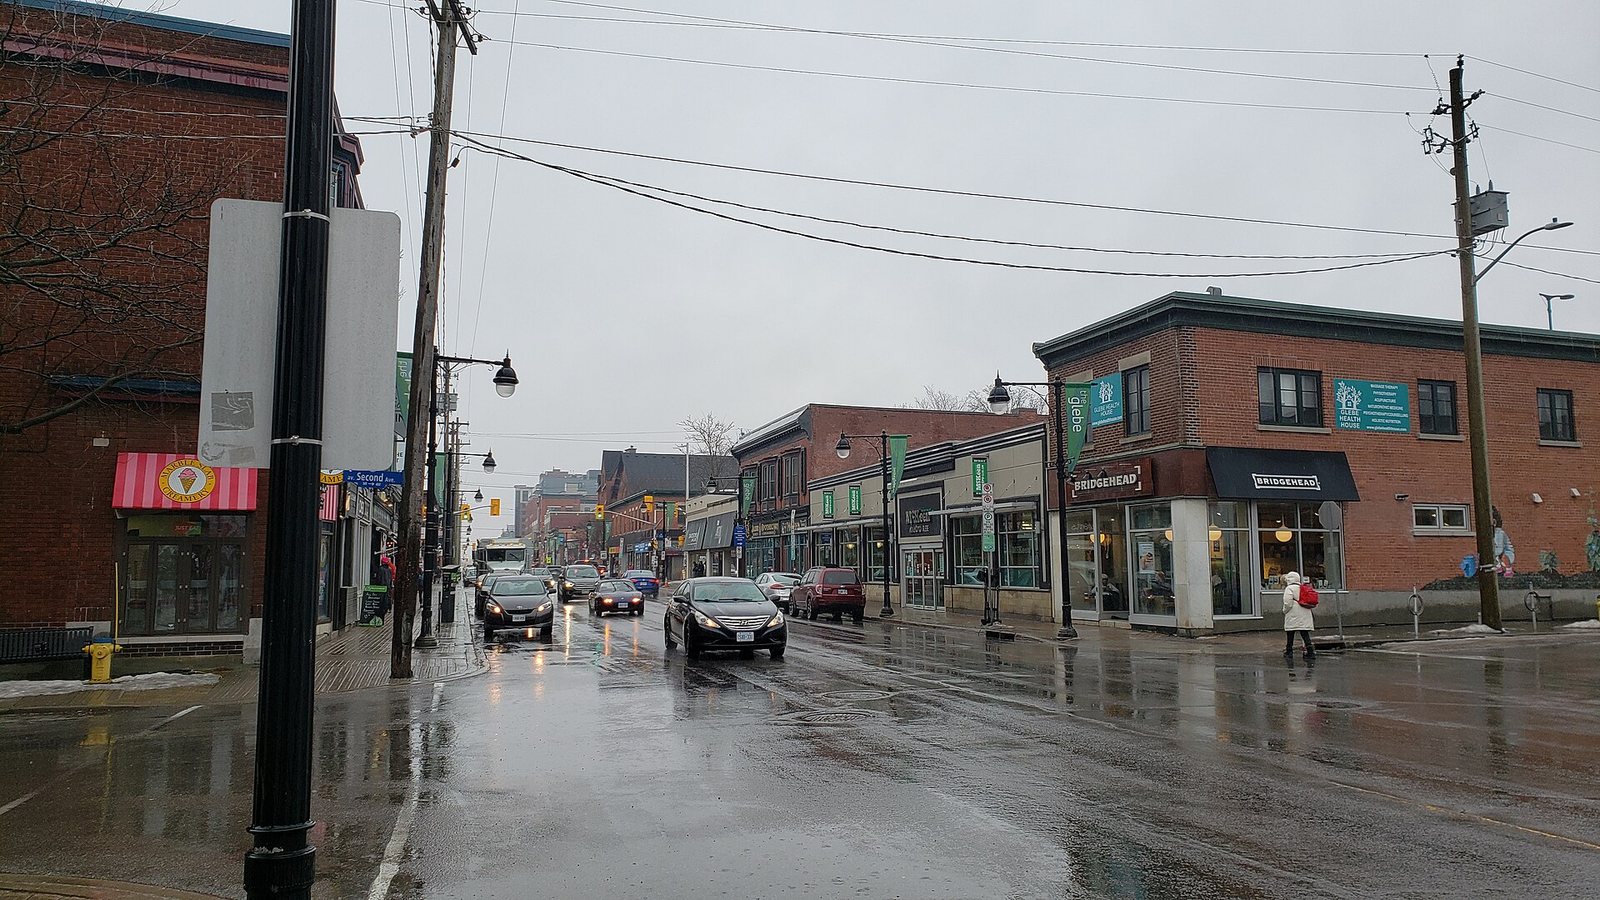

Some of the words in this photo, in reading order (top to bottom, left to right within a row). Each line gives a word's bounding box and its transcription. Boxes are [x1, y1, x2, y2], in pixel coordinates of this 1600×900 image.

[1068, 396, 1084, 432] glebe
[161, 460, 194, 478] MARBLE
[356, 472, 384, 482] Second
[1074, 474, 1137, 490] BRIDGEHEAD
[1256, 478, 1316, 486] BRIDGEHEAD
[162, 486, 208, 501] CREAMERY
